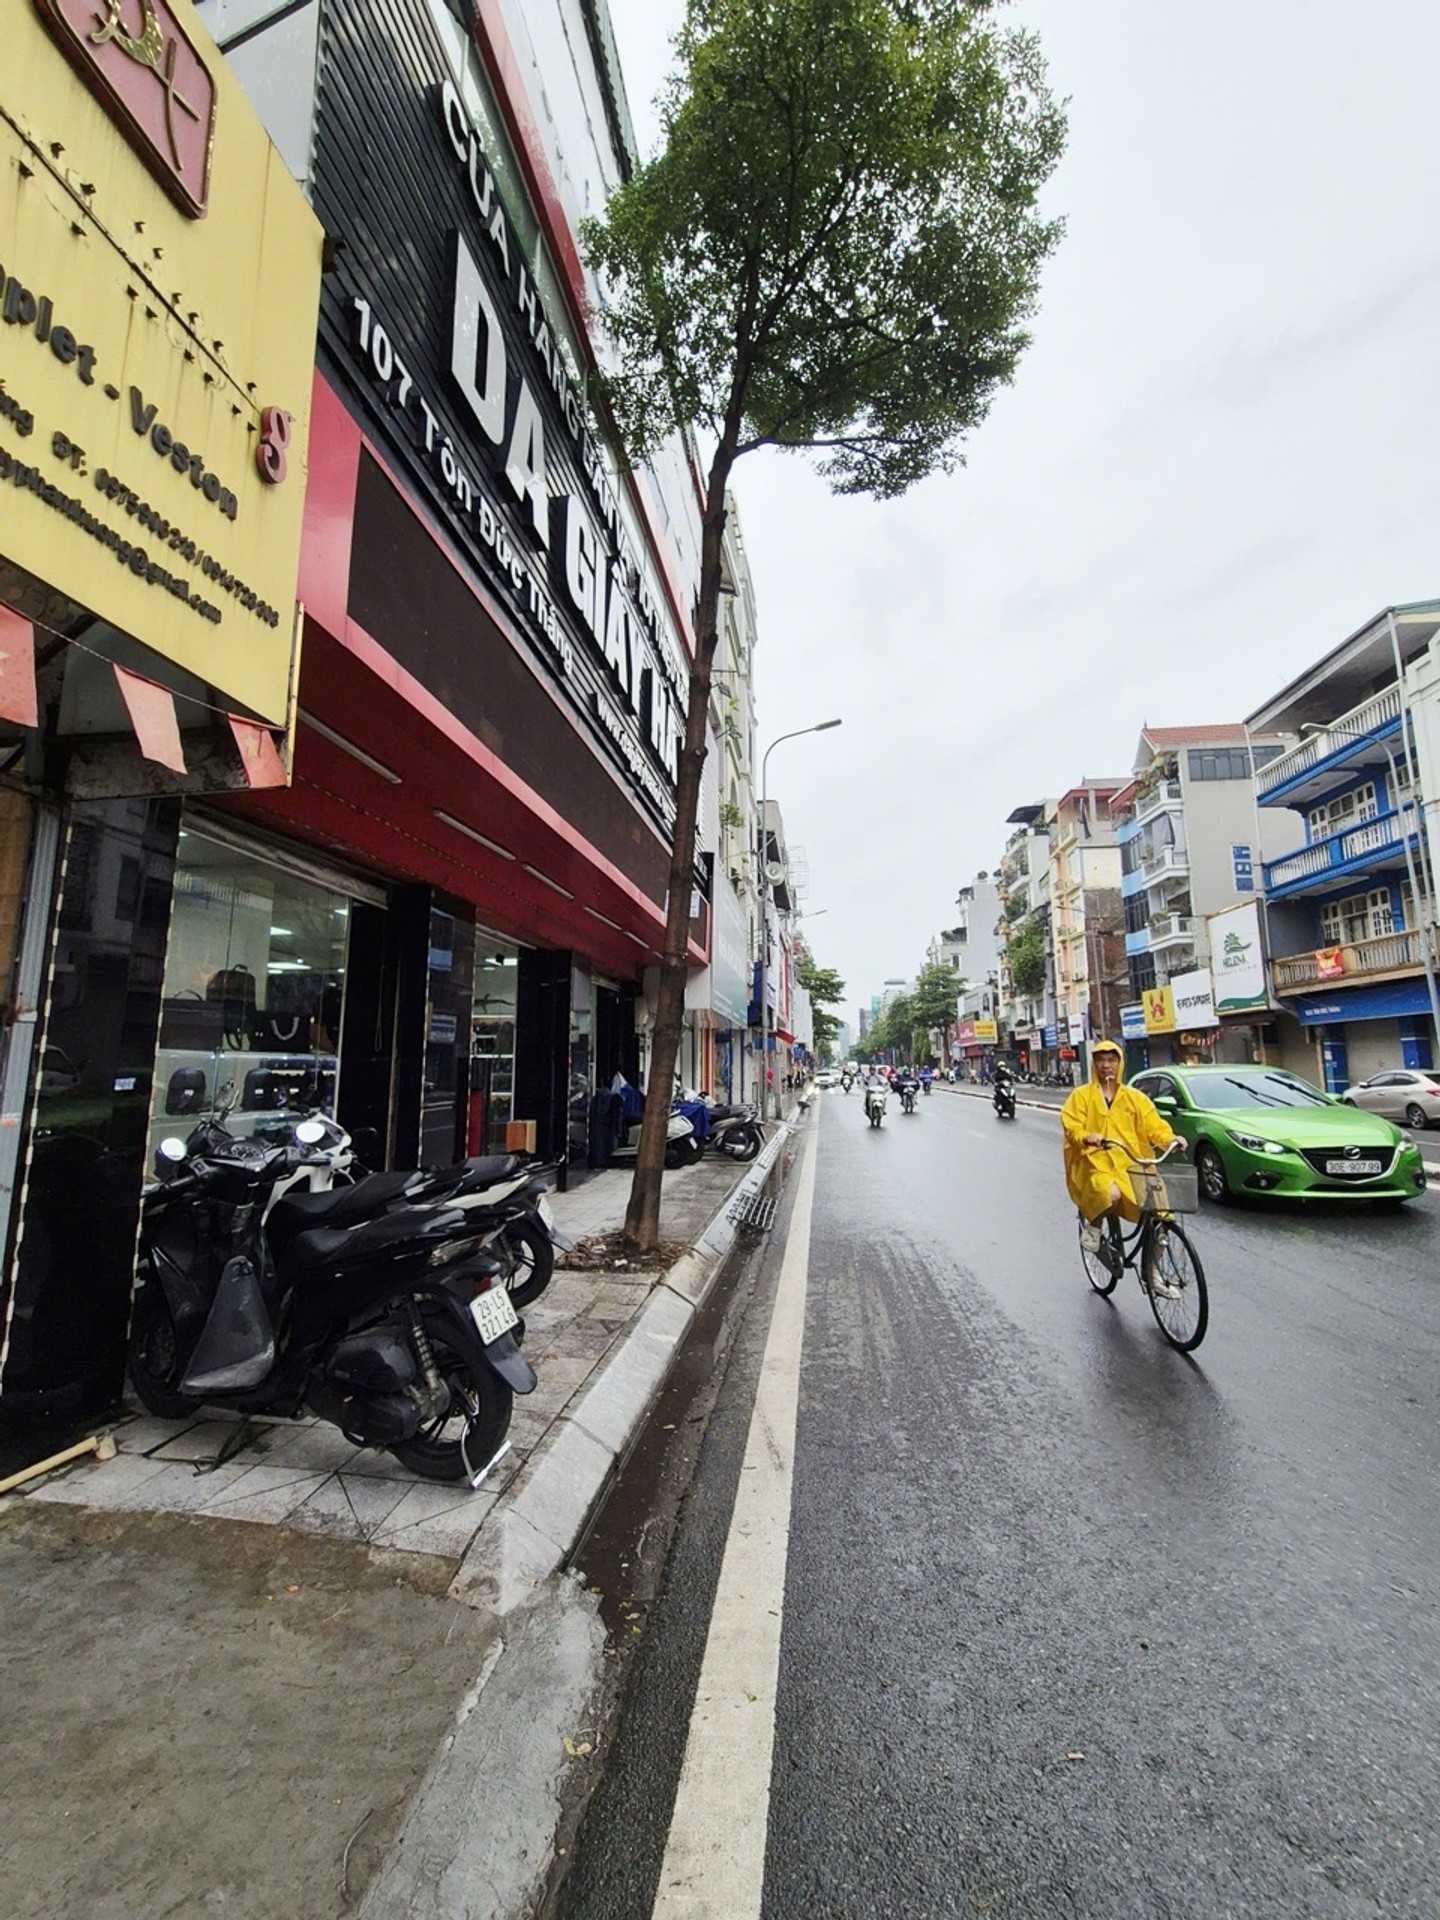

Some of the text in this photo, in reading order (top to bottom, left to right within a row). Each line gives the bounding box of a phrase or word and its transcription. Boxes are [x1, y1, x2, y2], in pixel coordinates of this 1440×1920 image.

[130, 385, 238, 521] Veston
[354, 298, 574, 676] 107 Tôn Đức Thắng
[452, 230, 549, 549] DA
